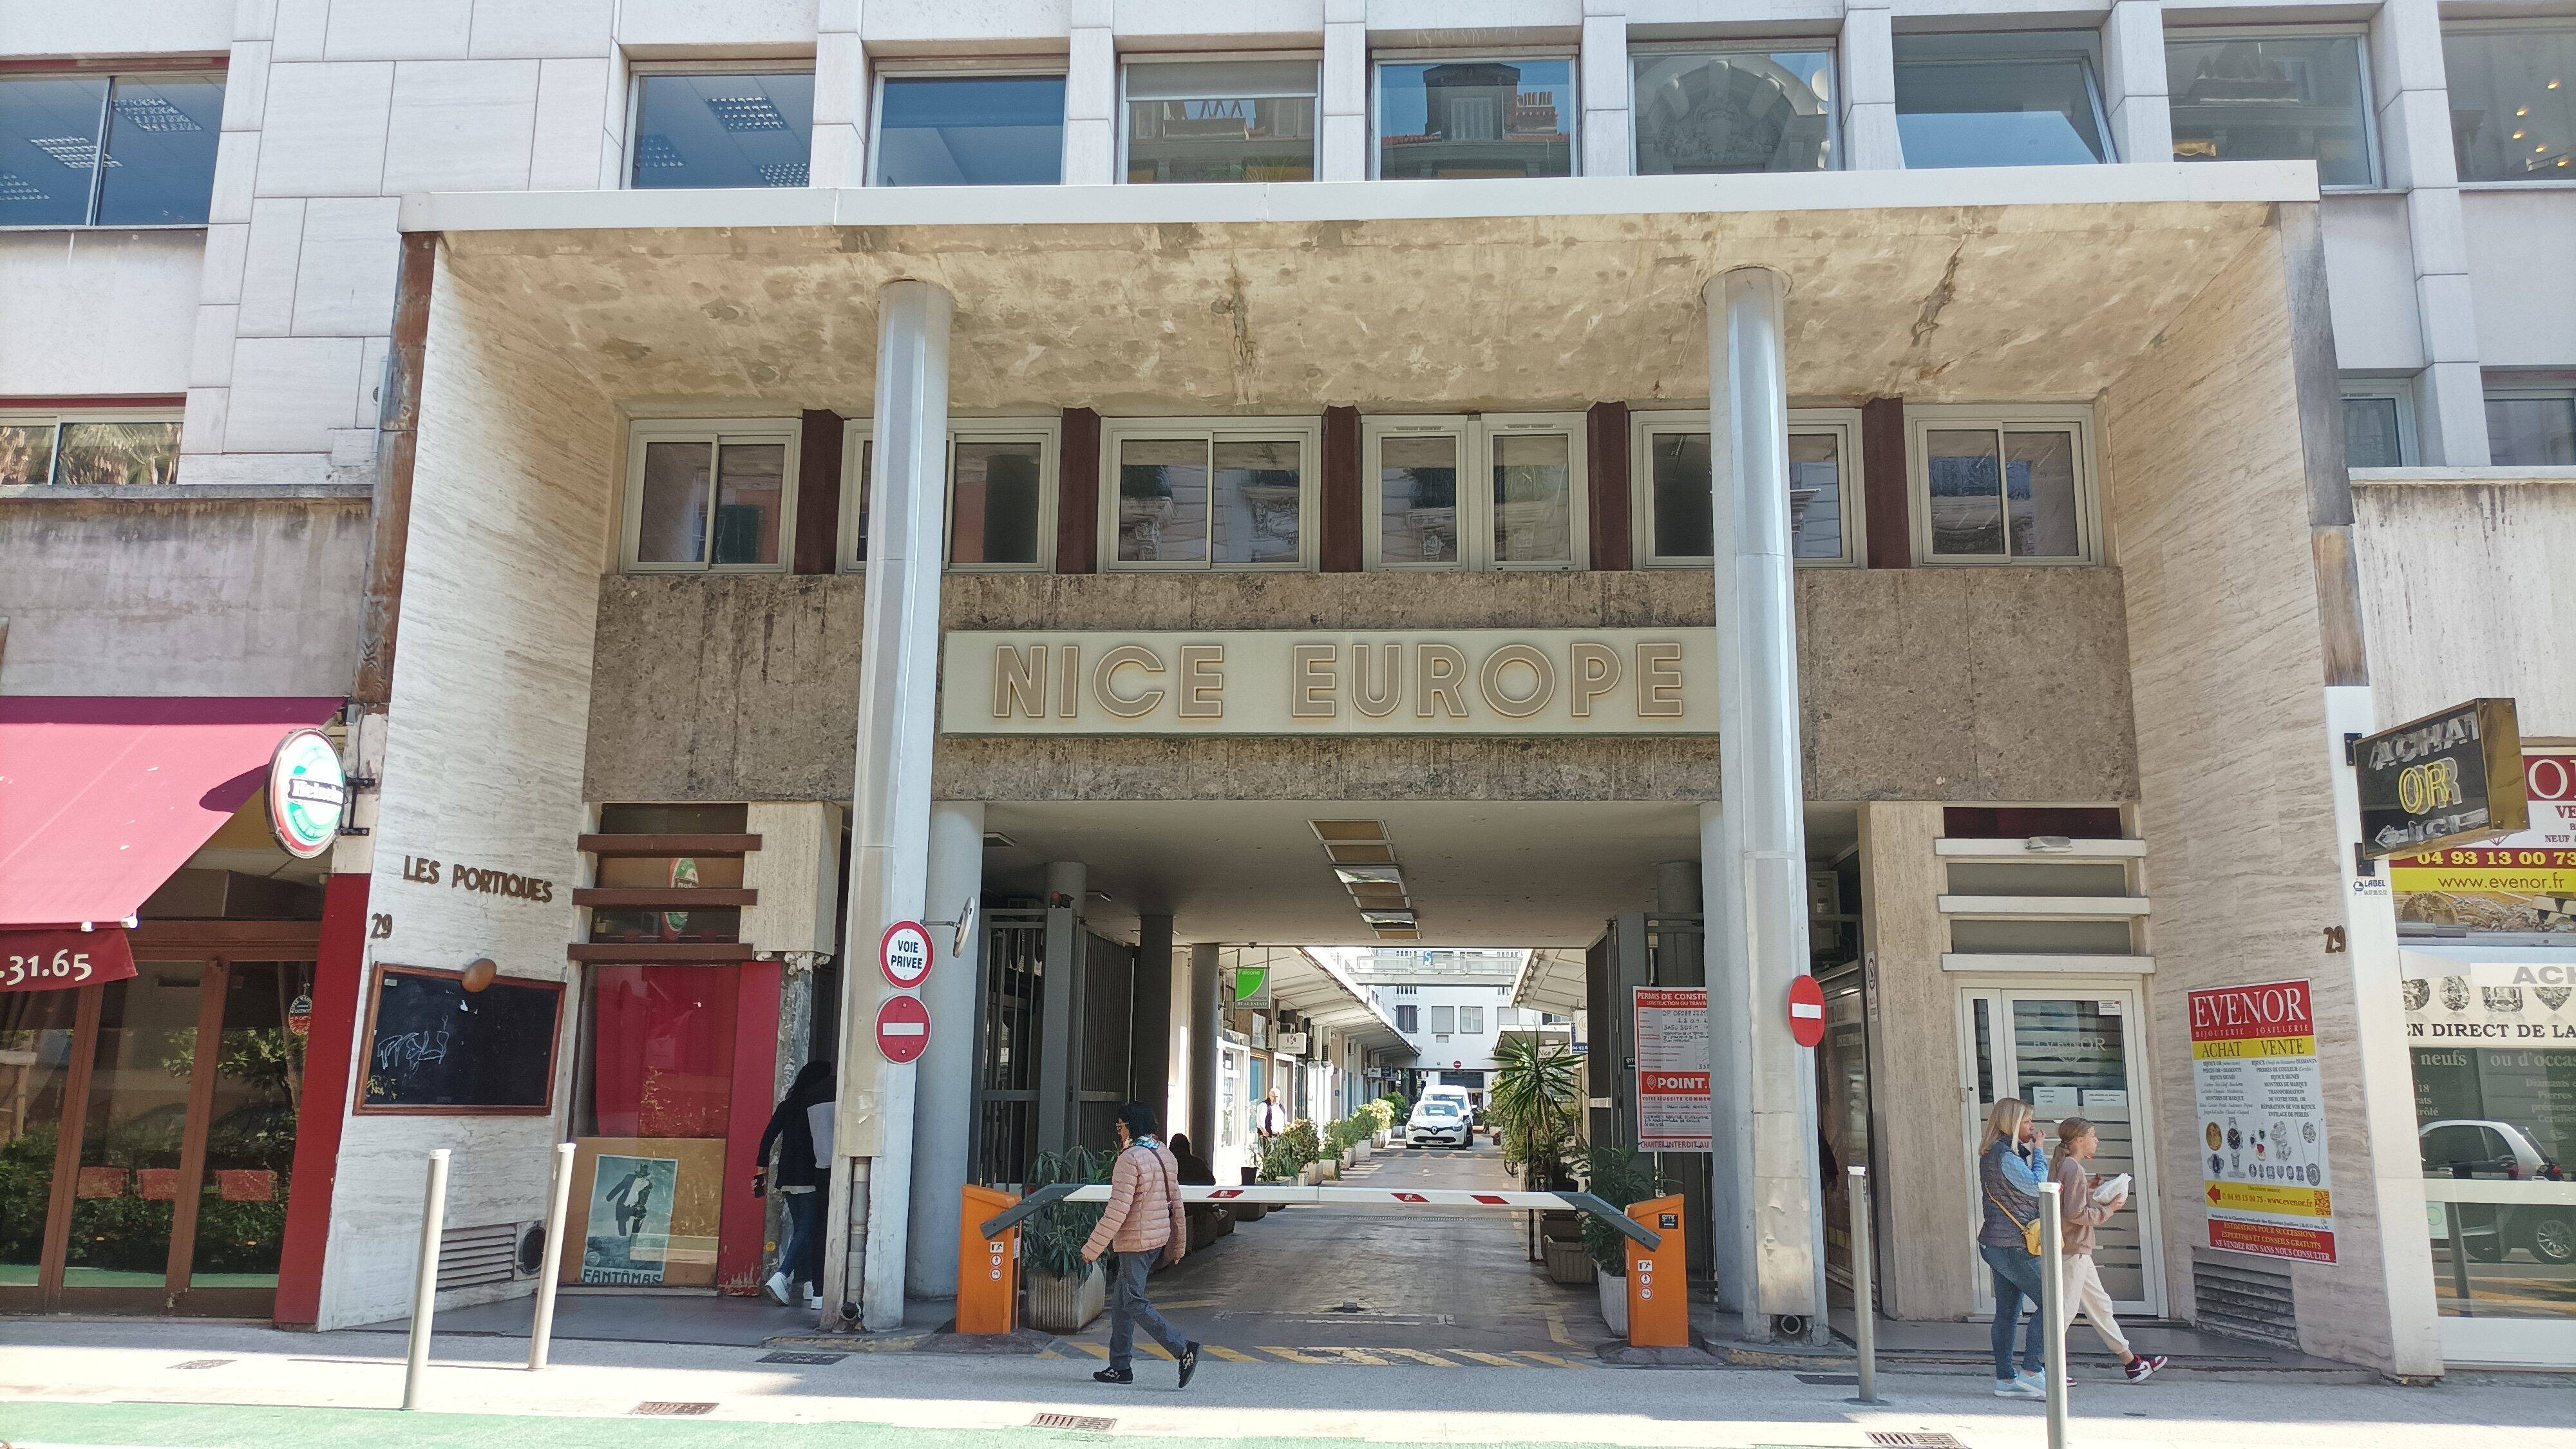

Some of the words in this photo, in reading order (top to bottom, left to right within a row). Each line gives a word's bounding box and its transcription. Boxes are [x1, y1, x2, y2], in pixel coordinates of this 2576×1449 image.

[993, 645, 1223, 718] NICE
[1292, 643, 1684, 718] EUROPE
[2369, 711, 2479, 770] ACHAT
[2399, 757, 2462, 815] OR
[2417, 852, 2444, 864] 04
[2450, 852, 2478, 865] 93
[2486, 852, 2512, 865] 13
[2519, 852, 2546, 865] 00
[2553, 852, 2576, 865] 73
[403, 855, 441, 885] LES
[451, 864, 553, 903] PORTIQUES
[2438, 872, 2564, 888] www.evenor.fr
[370, 912, 392, 939] 29
[898, 940, 918, 953] VOIE
[2324, 925, 2346, 953] 29
[891, 955, 922, 969] PRIVEE
[2192, 988, 2307, 1027] EVENOR
[2195, 1028, 2244, 1039] BIJOUTERIE
[2256, 1025, 2309, 1036] JOAILLERIE
[2431, 1023, 2509, 1037] DIRECT
[2517, 1025, 2546, 1037] DE
[2202, 1041, 2242, 1057] ACHAT
[2260, 1039, 2305, 1055] VENTE
[2420, 1050, 2467, 1066] neufs
[2490, 1054, 2512, 1066] ou
[2418, 1084, 2430, 1092] 18
[2267, 1198, 2313, 1207] www.evenor.fr
[2224, 1222, 2257, 1231] ESTIMATION
[2275, 1228, 2316, 1238] SUCCESSIONS
[2221, 1231, 2252, 1240] EXPERTISES
[2262, 1236, 2290, 1245] CONSEILS
[2291, 1239, 2321, 1249] GRATUITS
[2223, 1240, 2245, 1249] VENDEZ
[2260, 1245, 2275, 1254] SANS
[2275, 1247, 2292, 1256] NOUS
[2293, 1249, 2331, 1260] CONSULTER
[582, 1269, 664, 1284] FANTÔMAS
